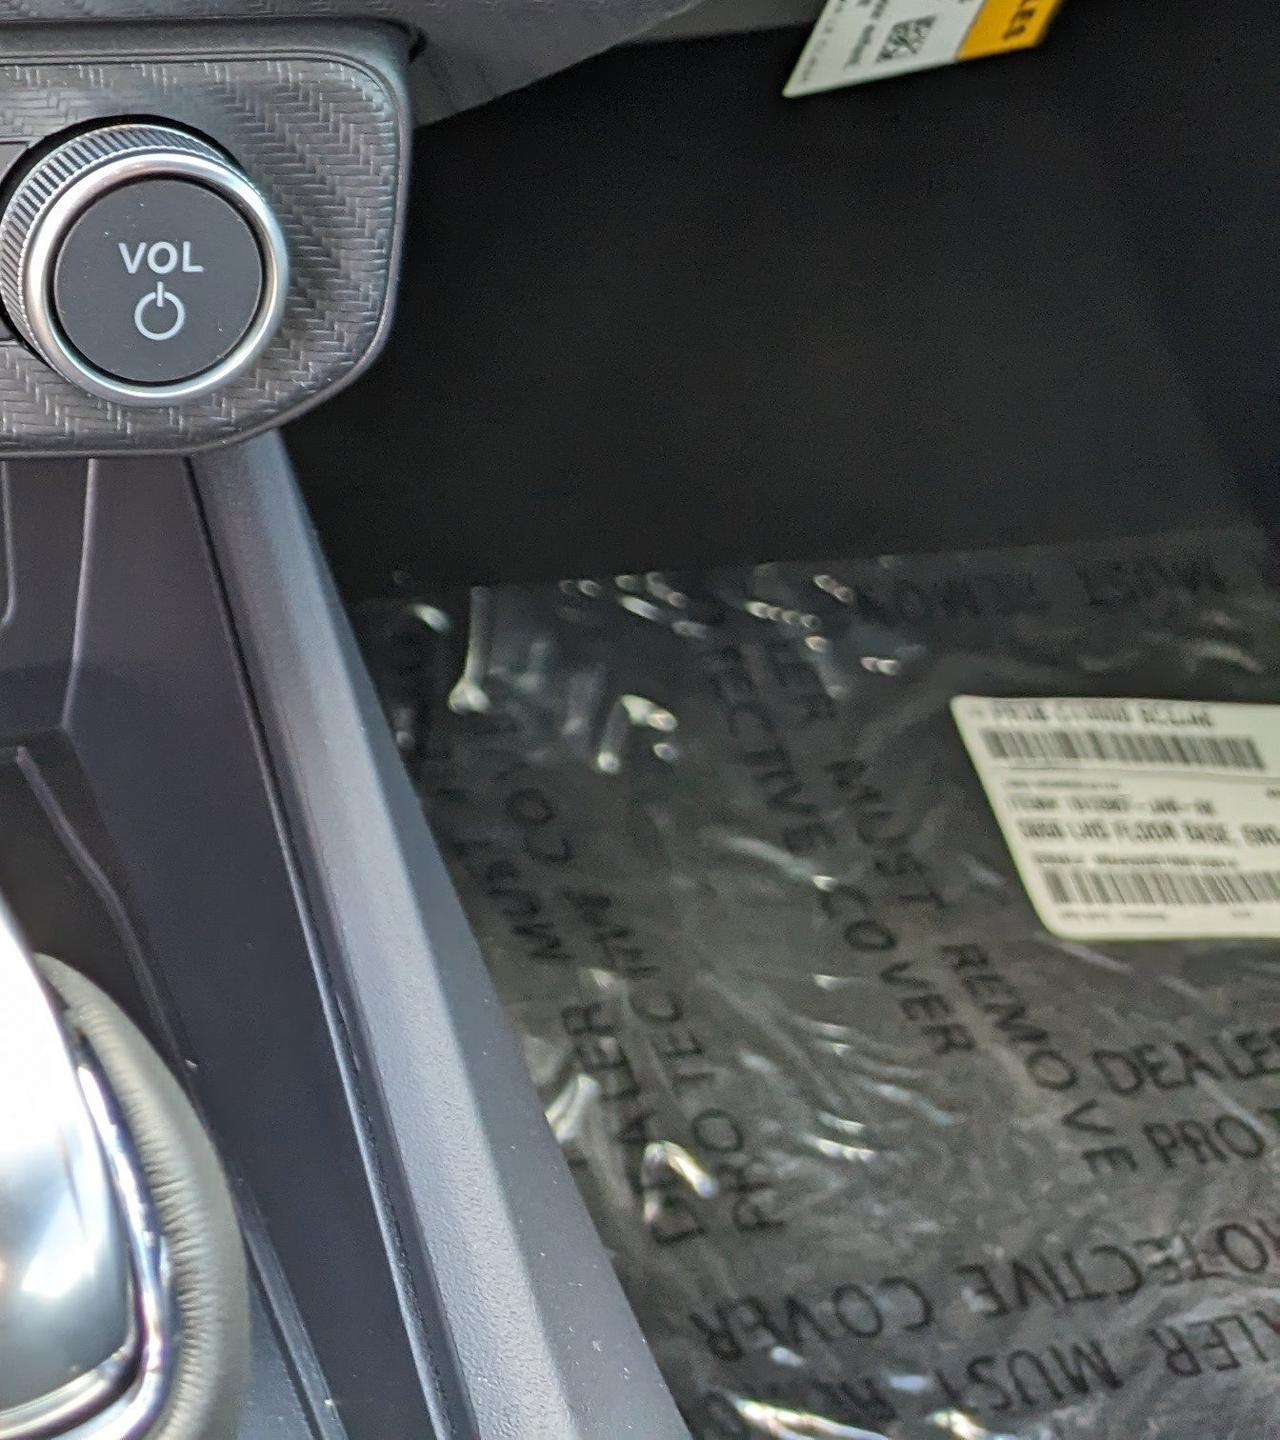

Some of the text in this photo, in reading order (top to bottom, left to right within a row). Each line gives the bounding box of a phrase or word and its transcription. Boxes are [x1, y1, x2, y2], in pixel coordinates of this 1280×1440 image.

[119, 242, 203, 274] VOL
[820, 886, 975, 1055] COVER
[942, 943, 1135, 1174] REMOVE
[687, 1275, 936, 1363] COVER
